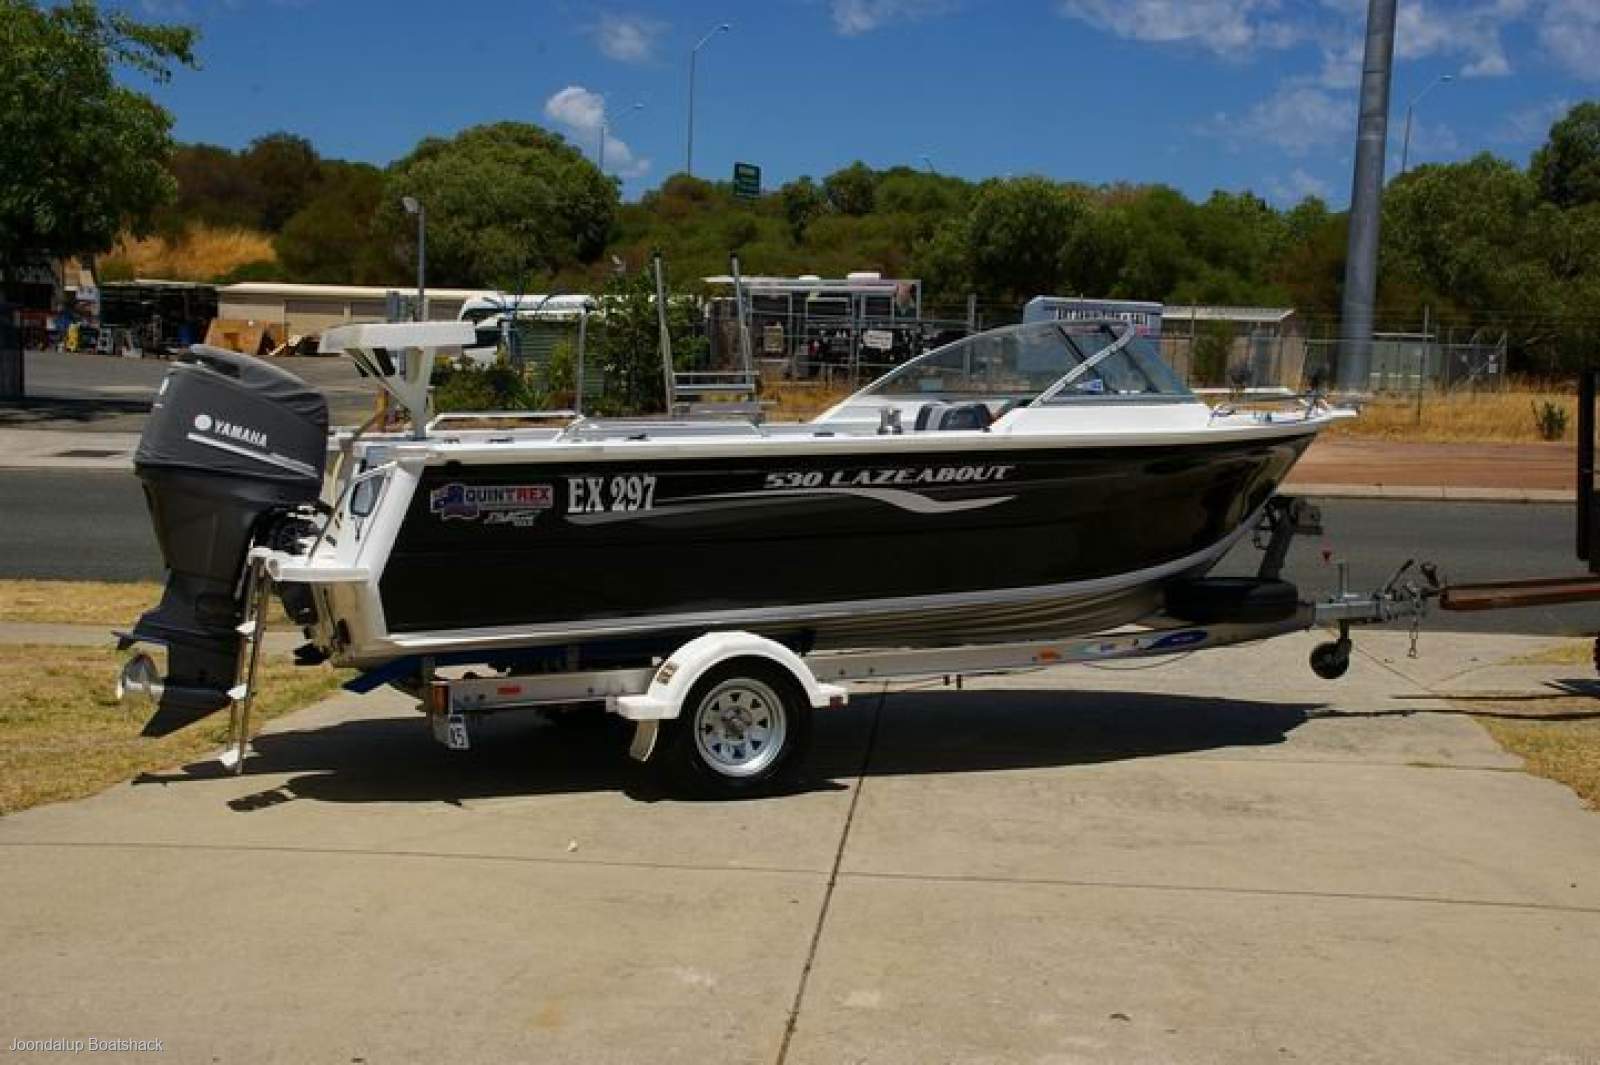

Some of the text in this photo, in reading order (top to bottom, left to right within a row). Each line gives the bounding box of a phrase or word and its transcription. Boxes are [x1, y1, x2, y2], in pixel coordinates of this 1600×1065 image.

[214, 419, 267, 447] YAMAHA
[765, 465, 1015, 488] 530 LAZEABOUT
[567, 475, 656, 513] EX 297
